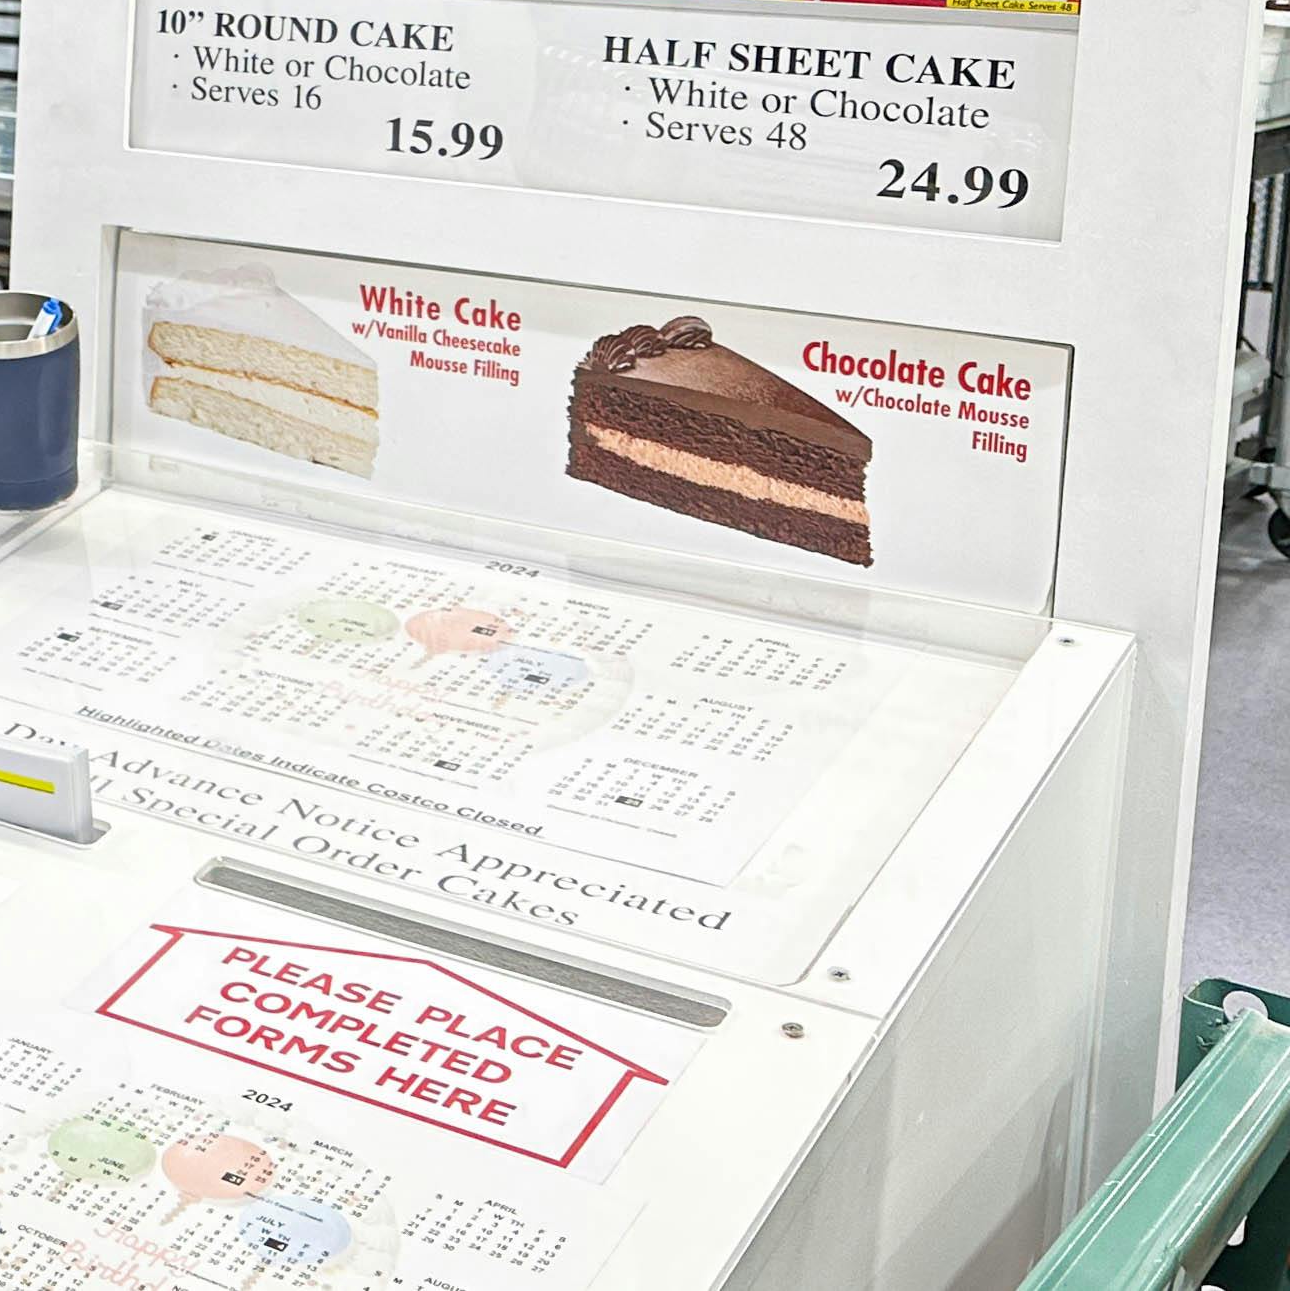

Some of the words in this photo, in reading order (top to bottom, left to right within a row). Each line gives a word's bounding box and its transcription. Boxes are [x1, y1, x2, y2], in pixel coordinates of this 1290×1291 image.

[999, 1, 1023, 11] Cake
[214, 12, 338, 44] ROUND
[350, 21, 454, 52] CAKE
[193, 45, 275, 75] White
[285, 57, 315, 78] or
[325, 55, 471, 90] Chocolate
[603, 35, 717, 70] HALF
[728, 42, 871, 80] SHEET
[885, 54, 1016, 90] CAKE
[191, 76, 279, 107] Serves
[293, 85, 322, 110] 16
[648, 77, 749, 111] White
[762, 93, 797, 114] or
[810, 89, 990, 130] Chocolate
[385, 117, 504, 160] 15.99
[645, 112, 753, 147] Serves
[766, 122, 808, 151] 48
[876, 158, 1029, 209] 24.99
[360, 284, 441, 320] White
[454, 297, 522, 331] Cake
[352, 320, 427, 344] w/Vanilla
[433, 330, 520, 357] Cheesecake
[410, 351, 468, 374] Mousse
[474, 360, 519, 386] Filling
[803, 341, 945, 388] Chocolate
[958, 361, 1032, 401] Cake
[836, 386, 951, 417] w/Chocolate
[958, 401, 1029, 429] Mousse
[972, 431, 1028, 462] Filling
[485, 560, 540, 579] 2024
[77, 705, 203, 748] Highlighted
[269, 756, 362, 796] Indicate
[366, 782, 449, 812] Costco
[456, 806, 545, 836] Closed
[623, 756, 699, 778] DECEMBER
[90, 749, 263, 806] Advance
[279, 797, 421, 849] Notice
[436, 843, 733, 931] Appreciated
[121, 786, 289, 841] Special
[292, 836, 422, 882] Order
[437, 875, 580, 928] Cakes
[221, 946, 404, 1017] PLEASE
[415, 1006, 584, 1072] PLACE
[219, 982, 513, 1087] COMPLETED
[183, 1005, 364, 1075] FORMS
[375, 1066, 518, 1127] HERE
[242, 1089, 293, 1113] 2024
[484, 1200, 518, 1215] APRIL
